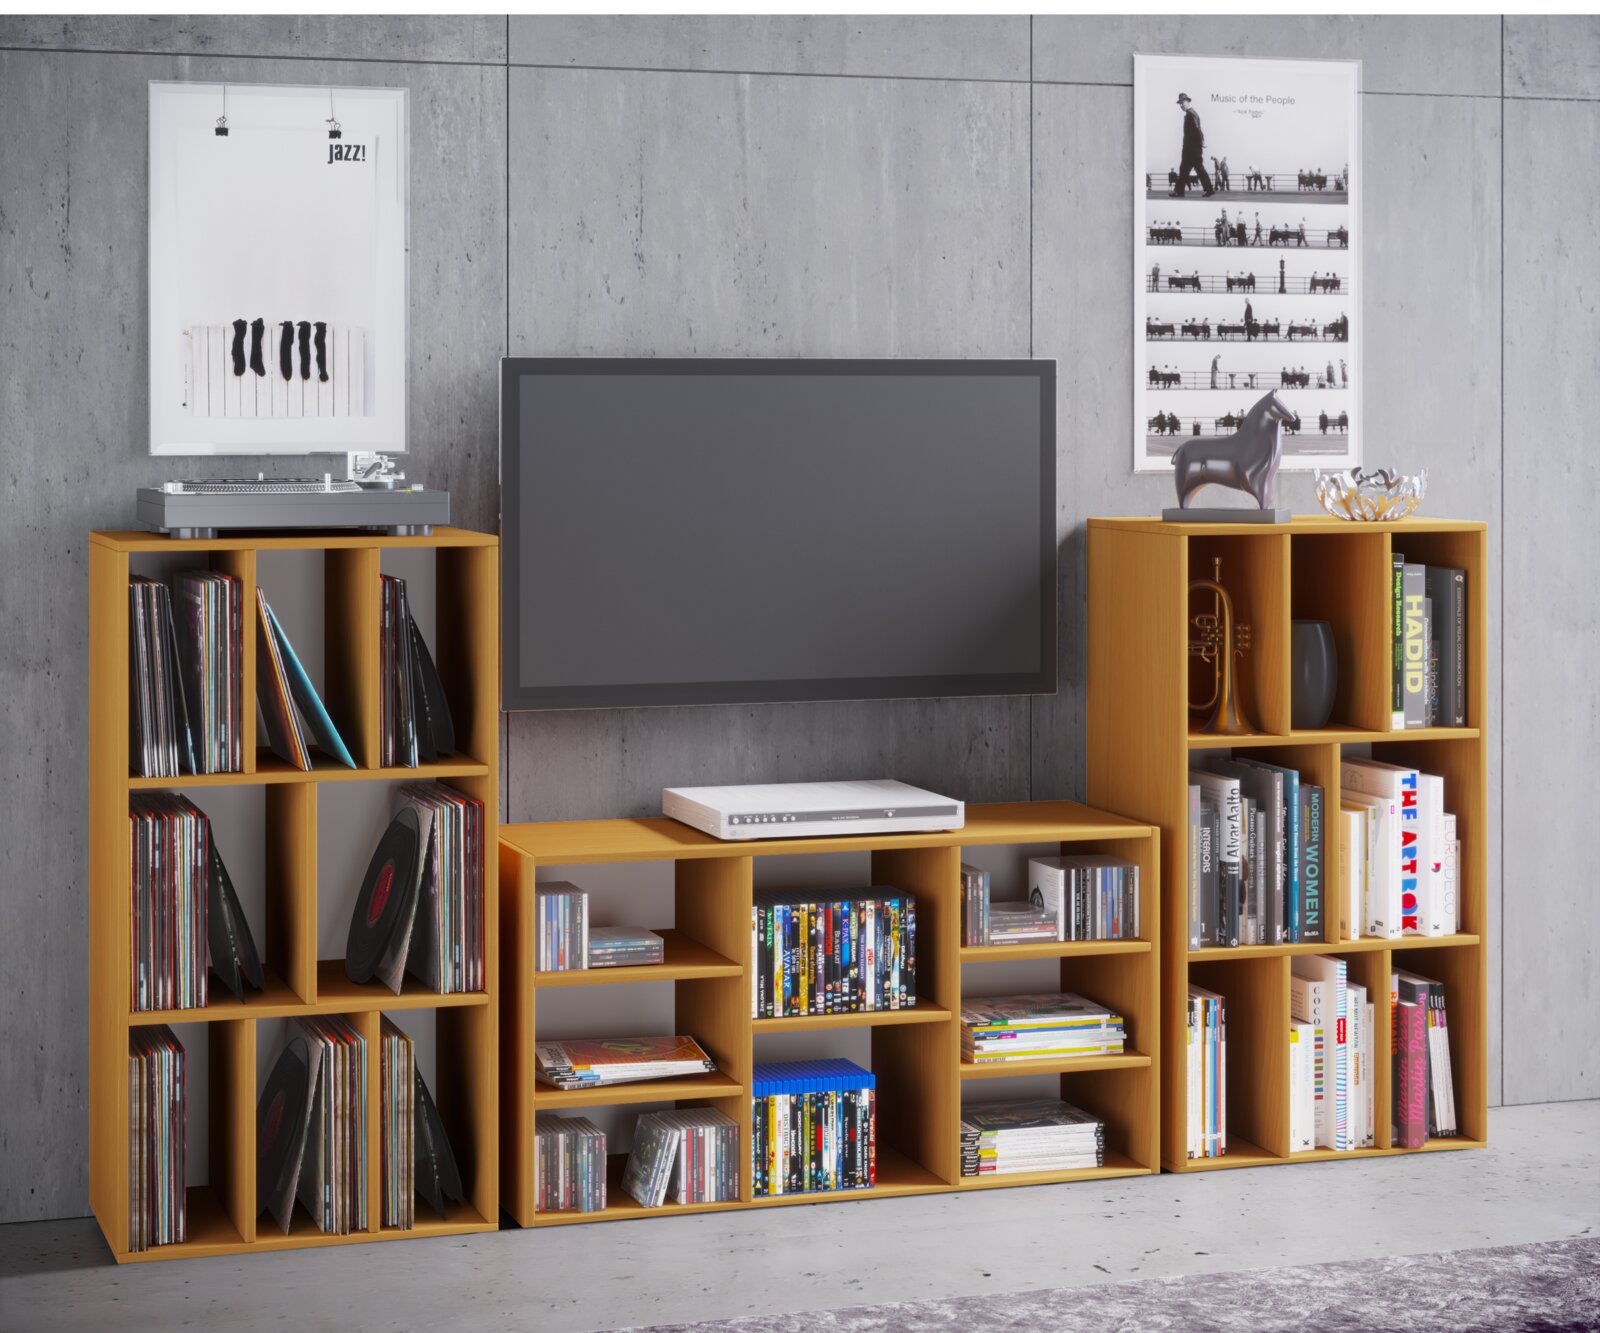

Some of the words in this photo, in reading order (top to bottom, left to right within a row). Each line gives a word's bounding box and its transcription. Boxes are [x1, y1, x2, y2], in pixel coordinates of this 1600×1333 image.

[1210, 93, 1237, 104] Music
[1239, 94, 1248, 104] of
[1250, 94, 1264, 104] the
[1266, 95, 1296, 106] People
[327, 144, 366, 165] jazz!
[1395, 571, 1403, 599] Design
[1395, 600, 1403, 637] Research
[1405, 595, 1423, 694] HADID
[1227, 787, 1240, 822] Aalto
[1311, 793, 1319, 842] MODERN
[1401, 773, 1417, 821] THE
[1202, 827, 1211, 873] INTERIORS
[1227, 824, 1239, 858] Alvar
[1249, 832, 1257, 858] Guitars
[1401, 831, 1417, 874] ART
[1306, 845, 1319, 925] WOMEN
[1444, 820, 1456, 915] EURODECO
[783, 950, 791, 988] AVATAR
[1409, 1007, 1424, 1052] Parr
[1409, 1056, 1424, 1121] Martin
